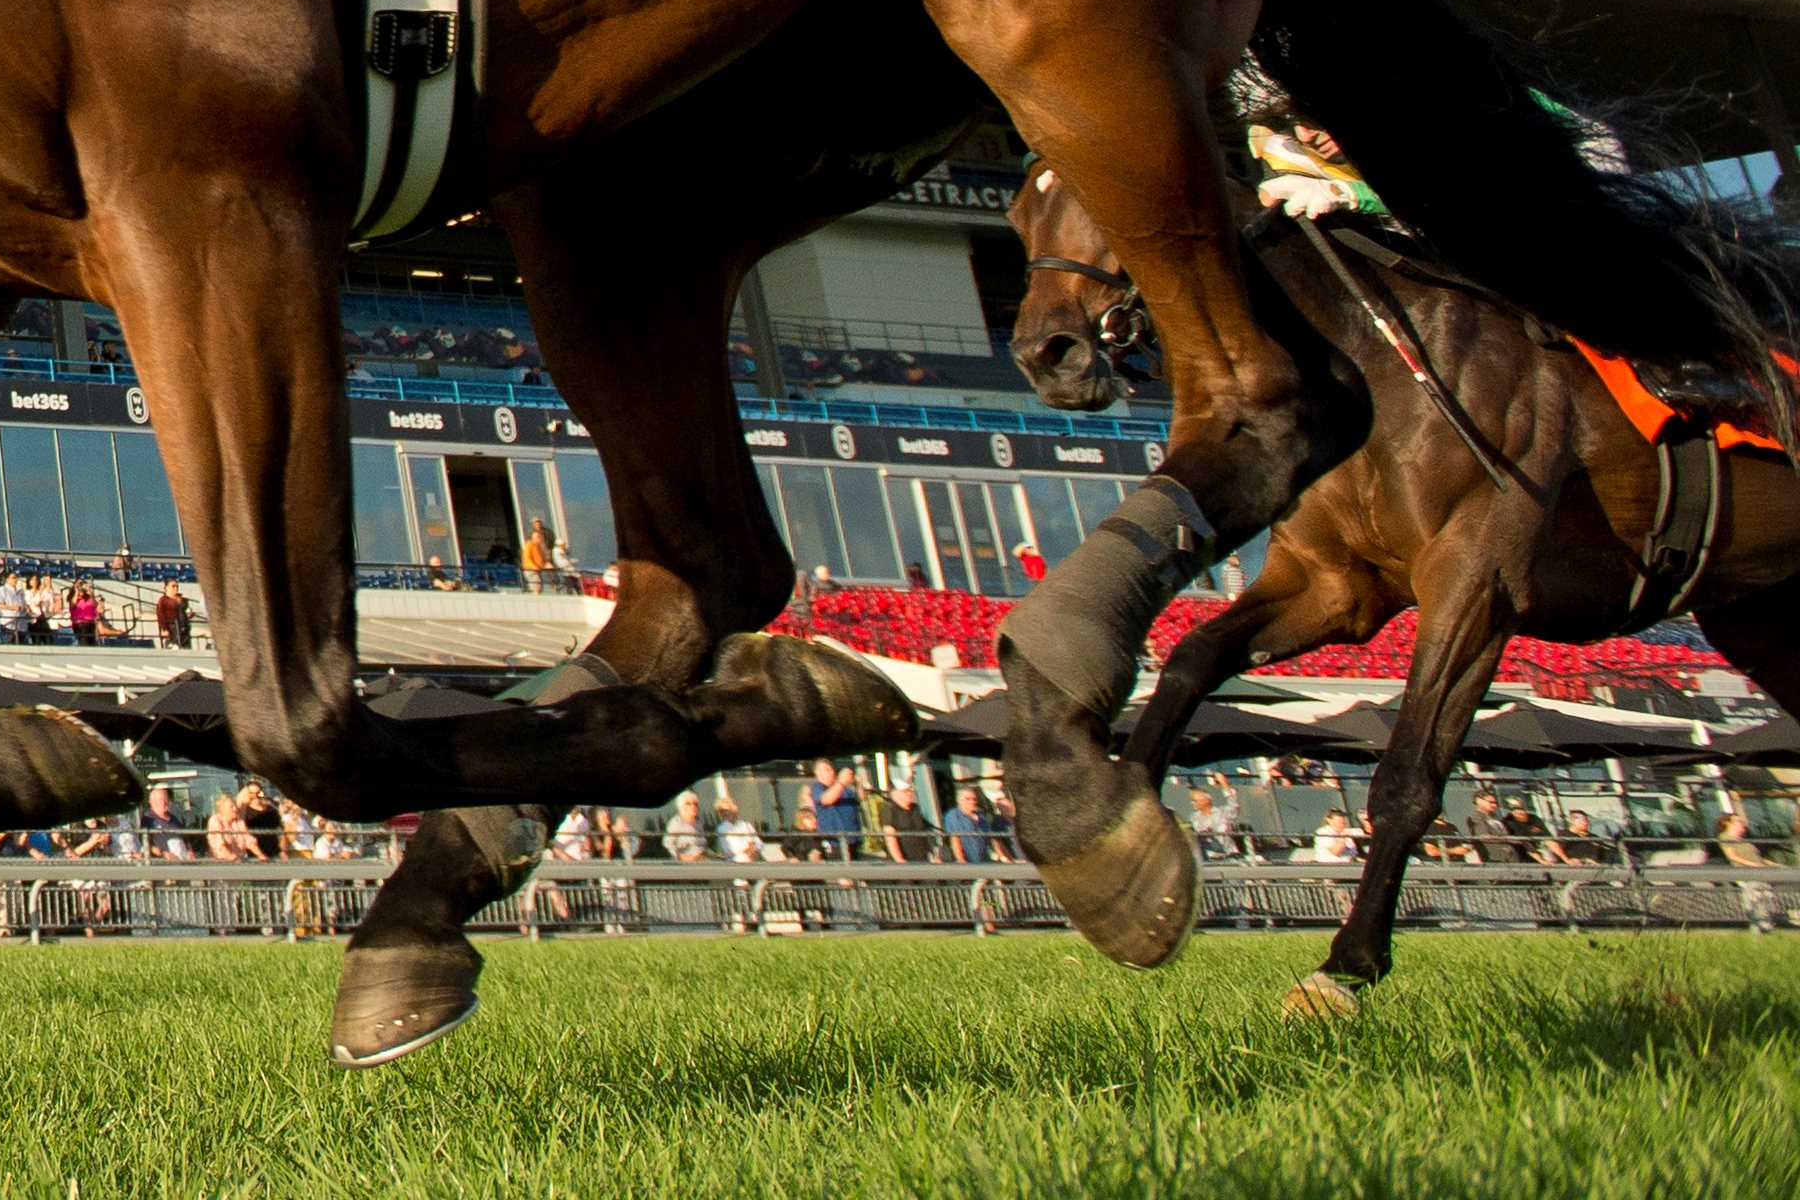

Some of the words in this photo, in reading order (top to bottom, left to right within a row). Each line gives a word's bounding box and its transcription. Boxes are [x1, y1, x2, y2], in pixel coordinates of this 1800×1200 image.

[10, 390, 70, 411] bet365
[388, 410, 444, 430] bet365
[745, 430, 787, 447] et365
